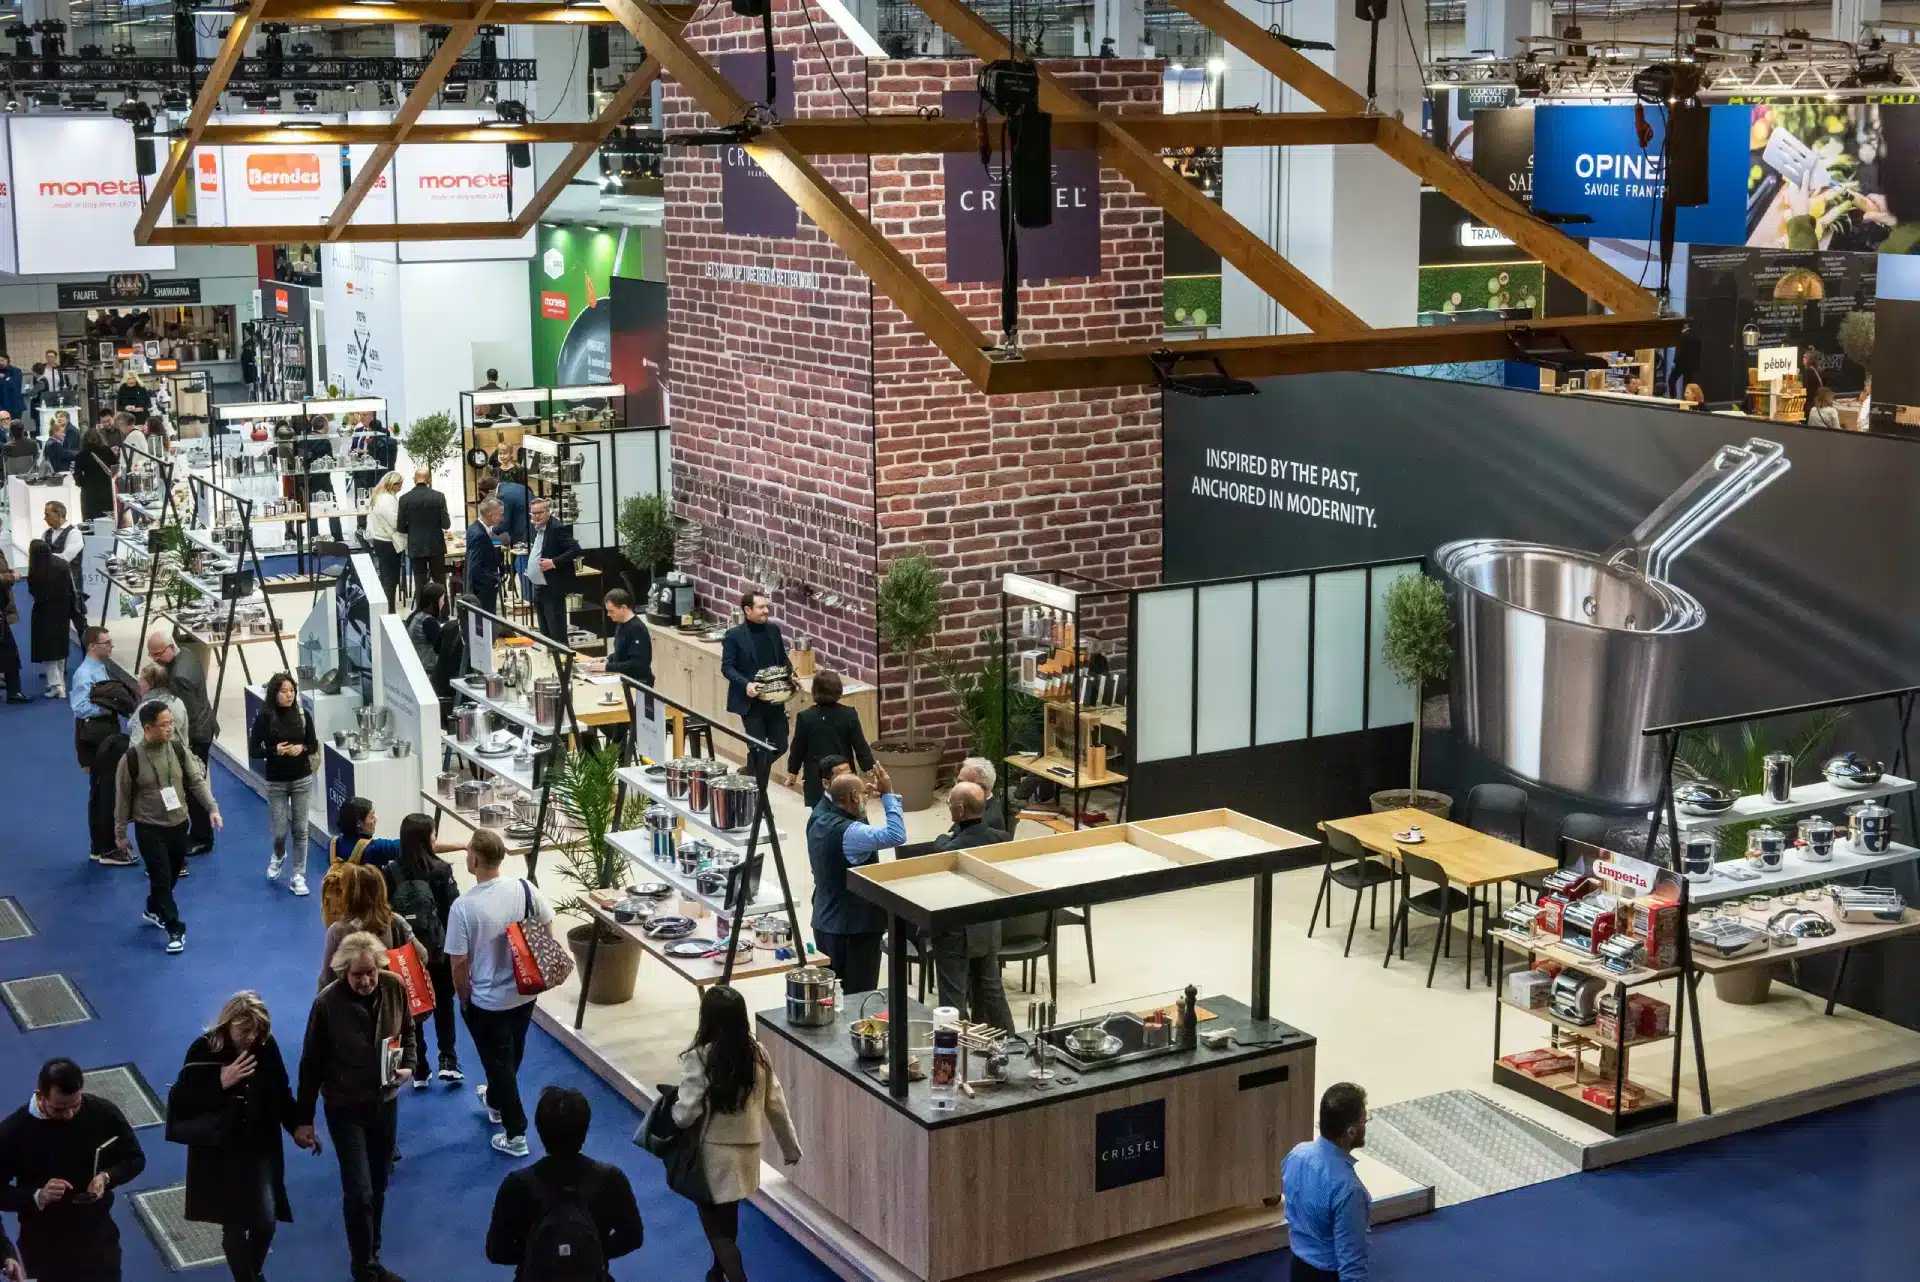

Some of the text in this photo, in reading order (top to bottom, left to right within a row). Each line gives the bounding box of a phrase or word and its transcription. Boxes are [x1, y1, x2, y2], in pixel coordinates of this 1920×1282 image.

[39, 179, 147, 197] moneta
[418, 173, 513, 189] moneta
[1584, 182, 1620, 197] SAVOIE
[959, 187, 1087, 212] CREL
[720, 263, 734, 279] COOK
[743, 266, 771, 284] TOGETHER
[777, 269, 798, 288] BETTER
[798, 271, 820, 290] WORLD
[73, 291, 99, 301] FALAFEL
[154, 287, 190, 298] SHAWARMA
[1206, 448, 1360, 496] INSPIRED BY THE PAST,
[1192, 476, 1378, 529] ANCHORED IN MODERNITY.
[1598, 862, 1648, 888] imperia
[507, 934, 529, 977] MARUSHIN
[397, 954, 417, 1001] MARUSHIN
[1101, 1140, 1160, 1161] CRISTEL
